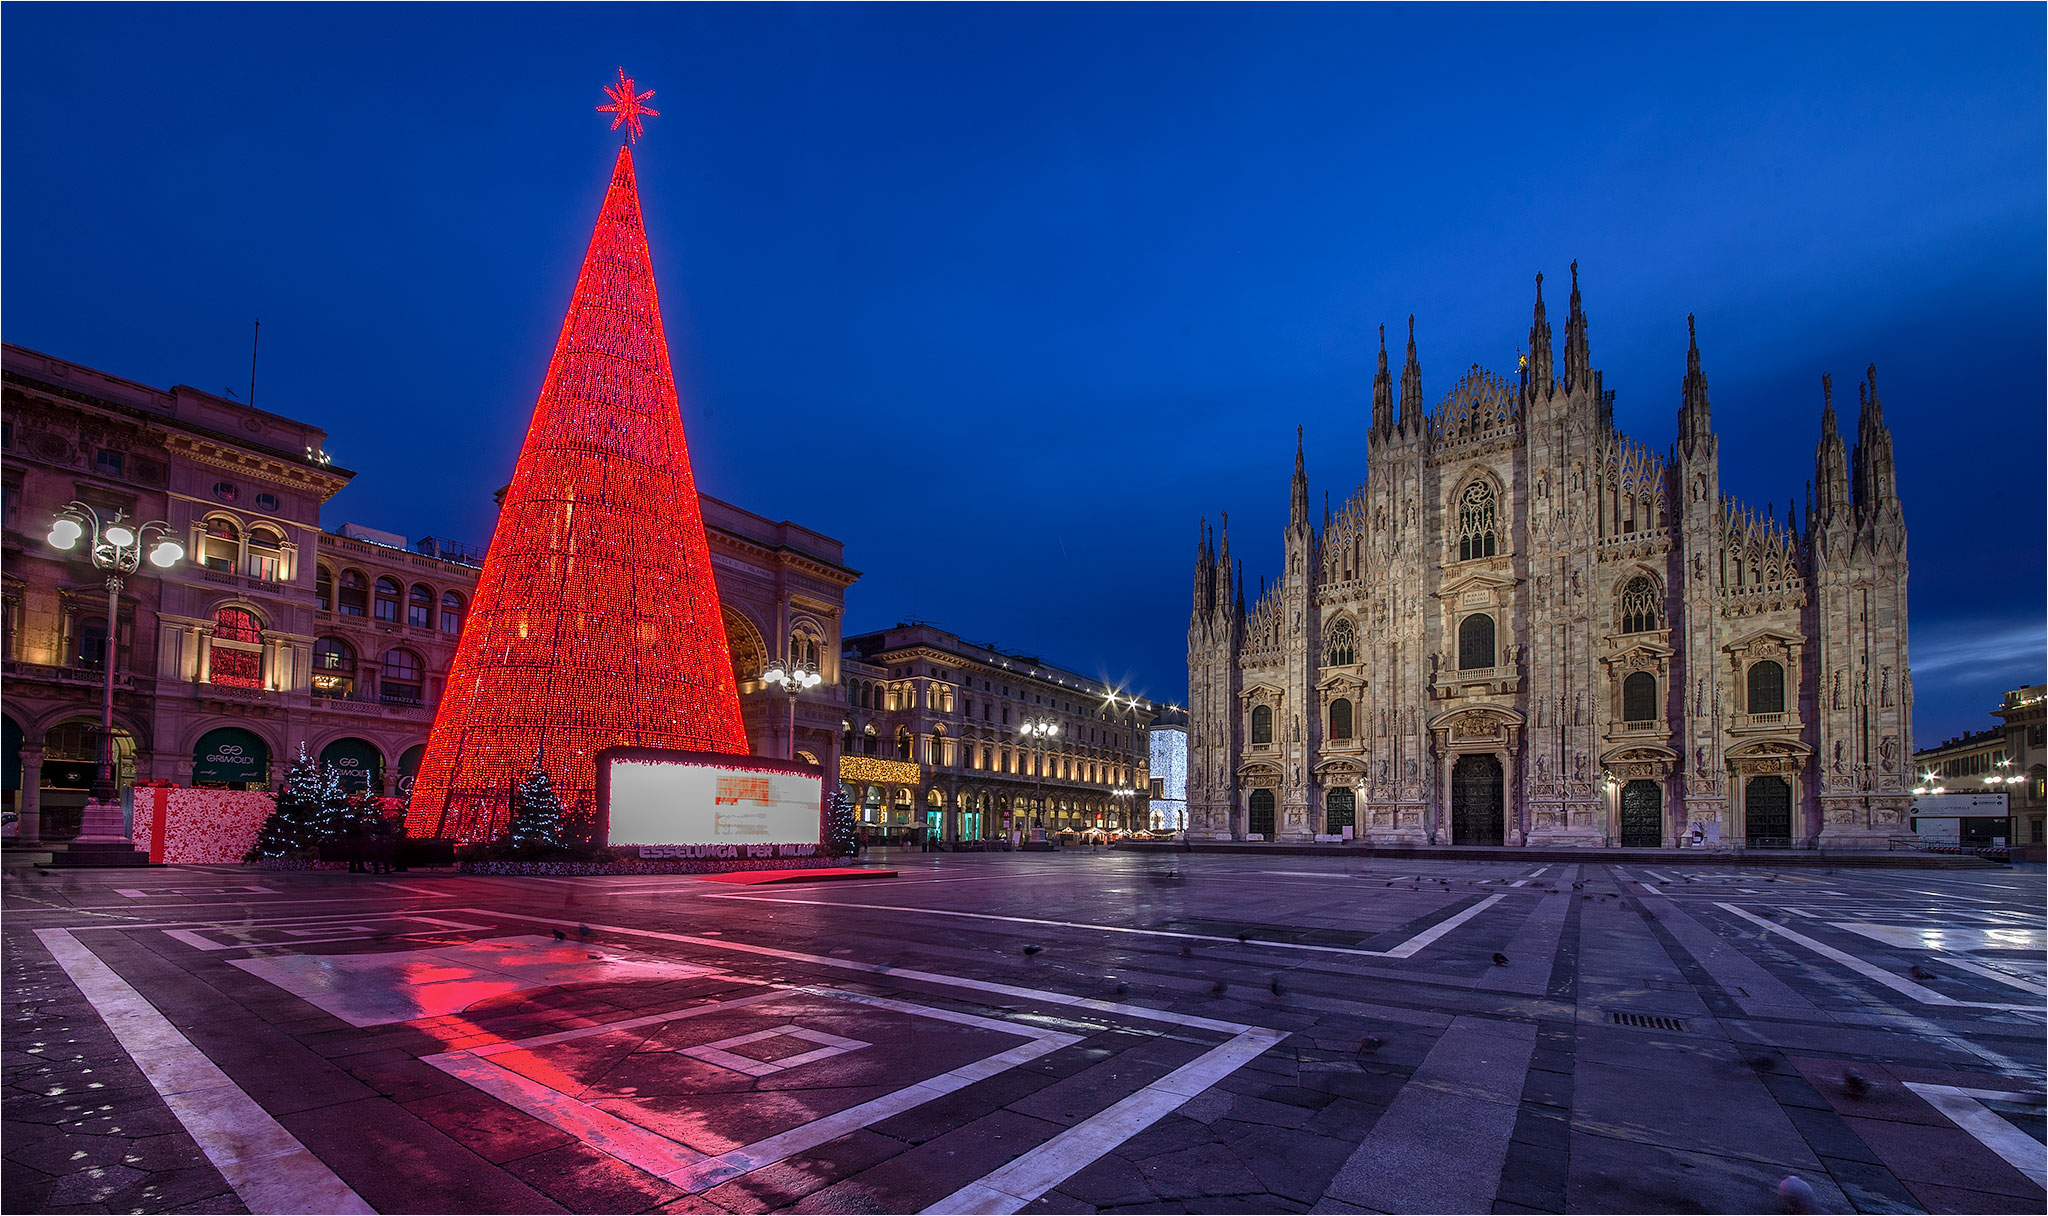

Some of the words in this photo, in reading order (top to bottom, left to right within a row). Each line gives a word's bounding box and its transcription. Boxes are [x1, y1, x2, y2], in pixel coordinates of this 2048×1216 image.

[206, 754, 254, 764] GRIMOLDI
[639, 846, 738, 859] ESSELUNGA
[746, 845, 773, 858] PER
